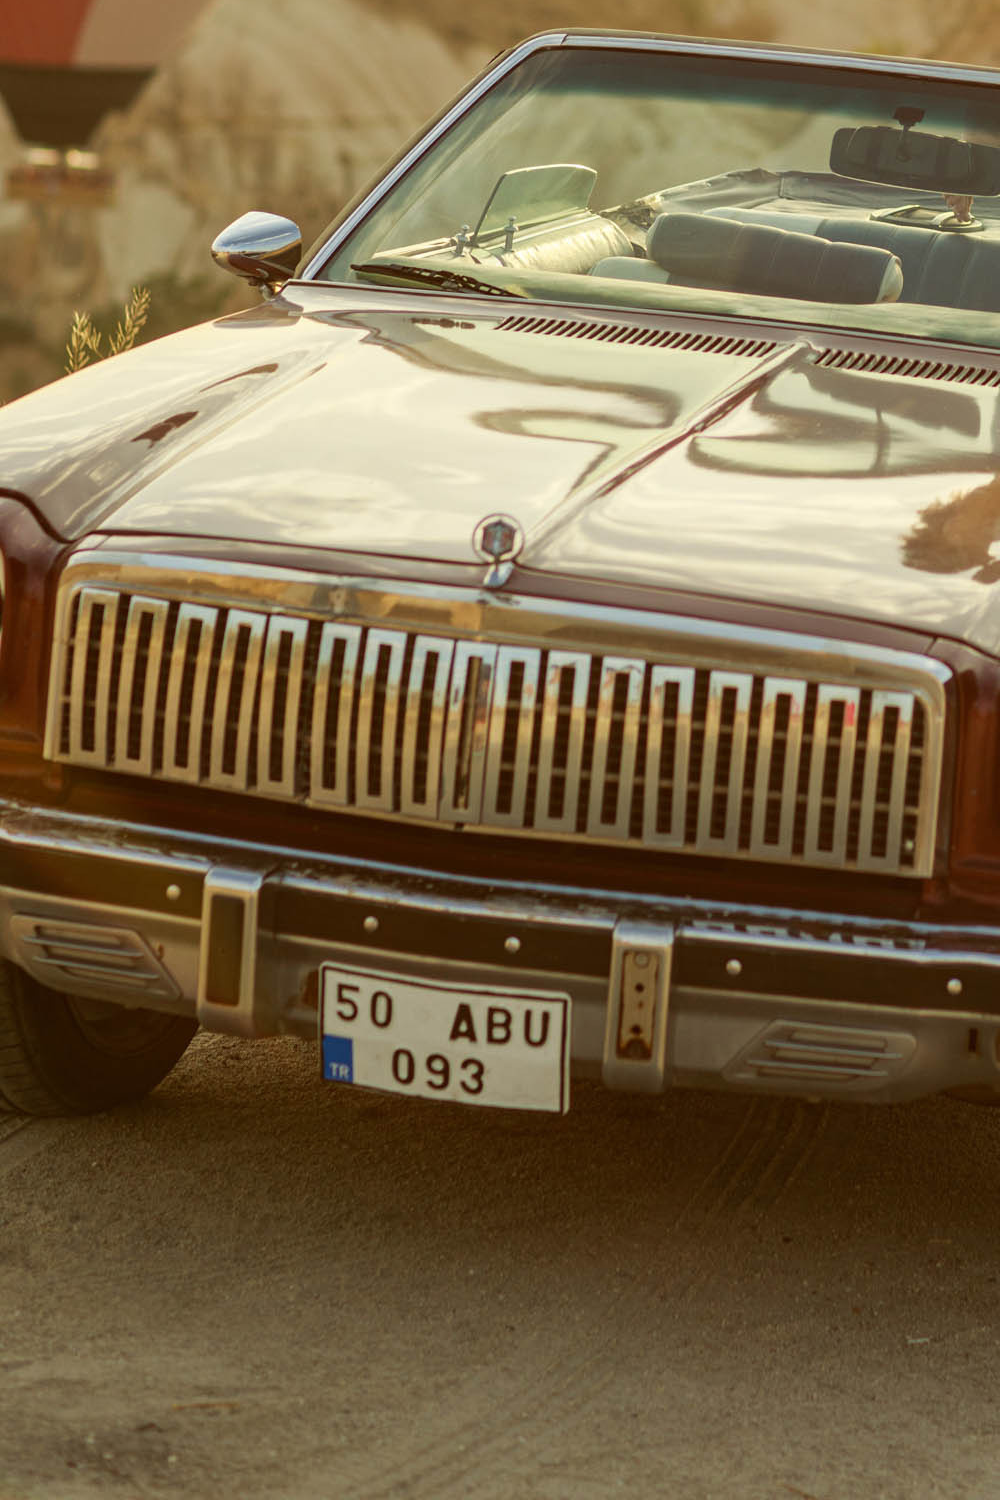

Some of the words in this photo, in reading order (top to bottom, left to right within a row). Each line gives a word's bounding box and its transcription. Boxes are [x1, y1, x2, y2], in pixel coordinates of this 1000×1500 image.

[336, 983, 393, 1029] 50
[450, 1003, 550, 1047] ABU
[329, 1062, 351, 1080] TR
[392, 1048, 485, 1095] 093
